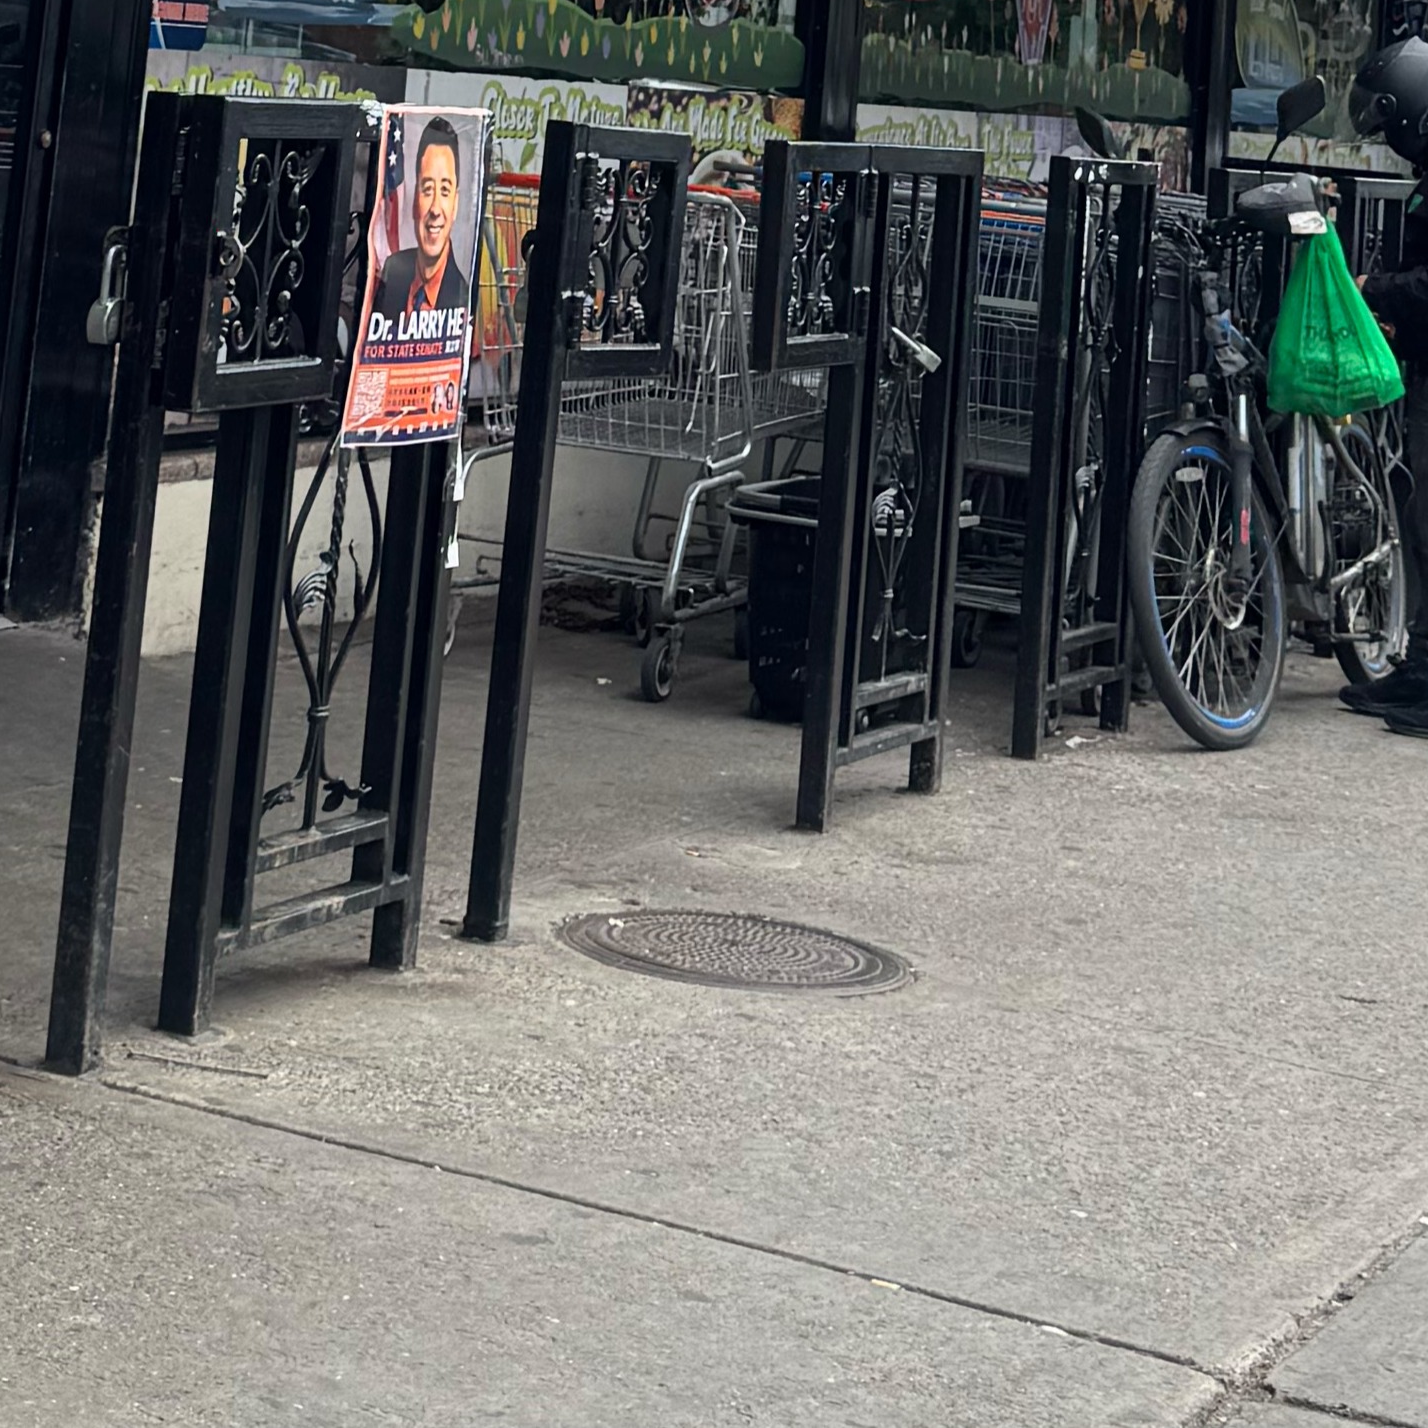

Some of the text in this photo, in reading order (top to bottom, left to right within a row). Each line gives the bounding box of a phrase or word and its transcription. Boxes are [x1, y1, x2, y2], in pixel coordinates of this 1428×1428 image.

[367, 307, 465, 342] Dr. LARRY HE
[364, 345, 384, 359] FOR
[387, 343, 414, 358] STATE
[415, 341, 442, 356] SENATE
